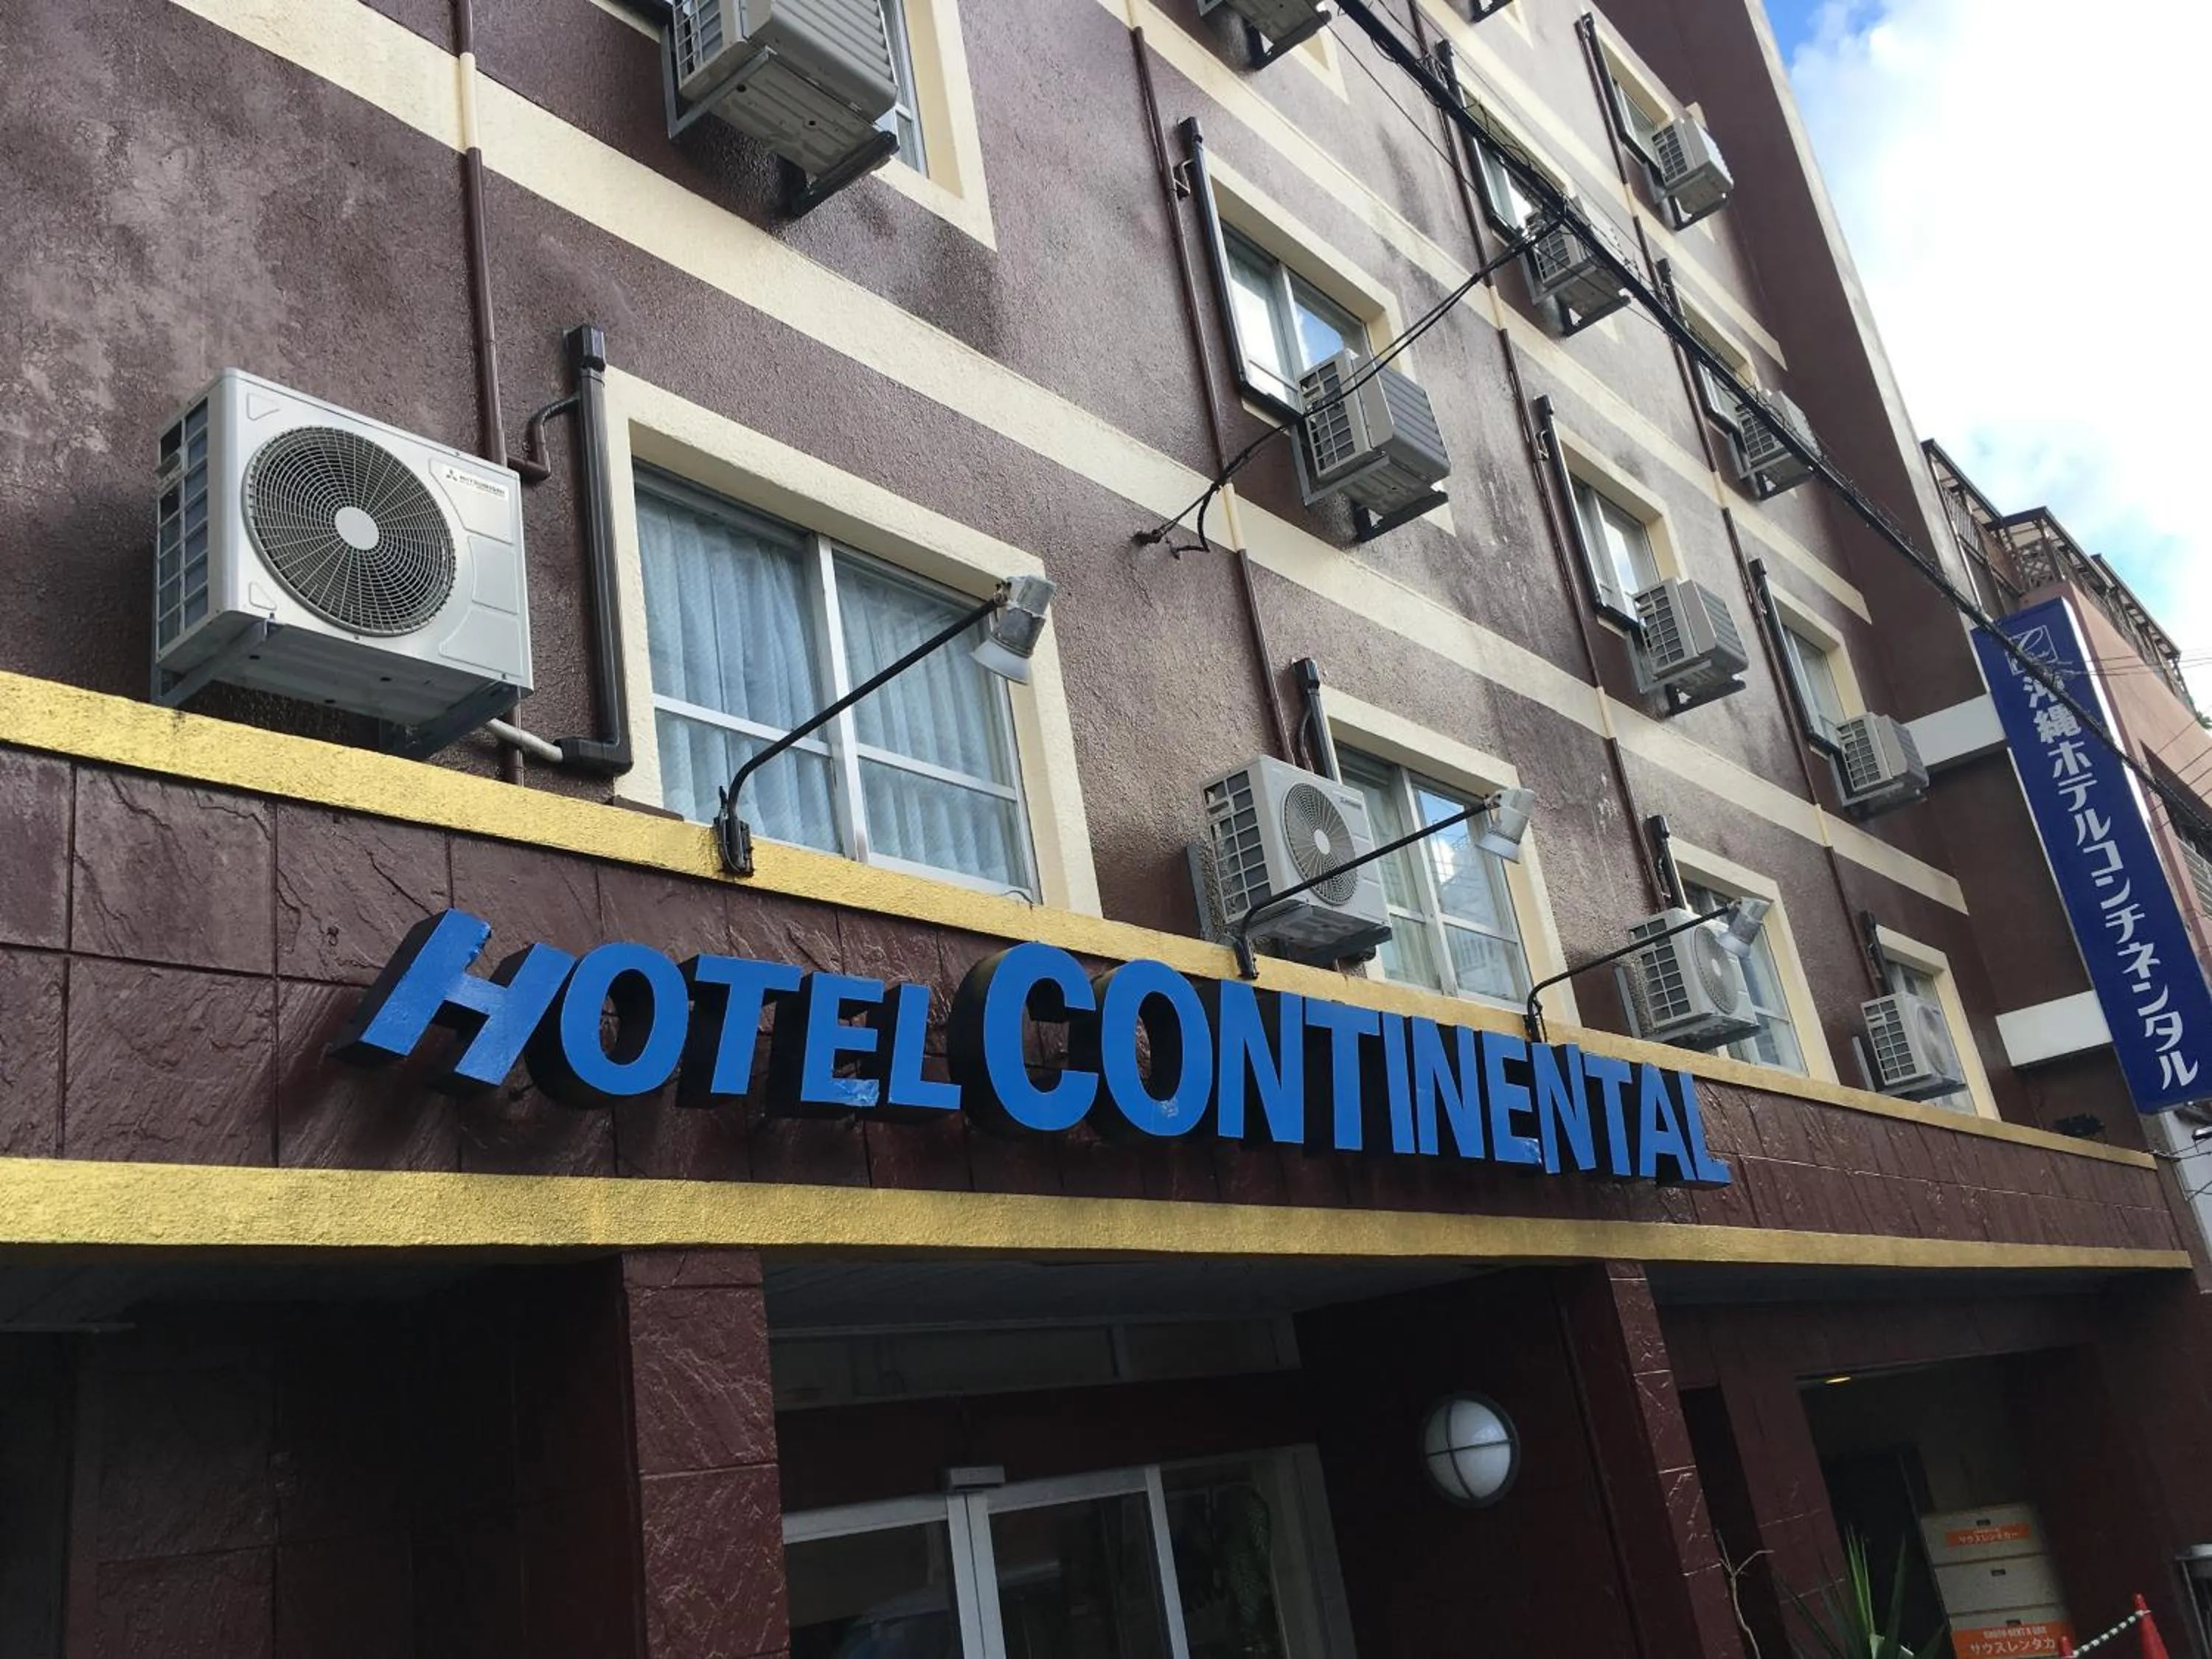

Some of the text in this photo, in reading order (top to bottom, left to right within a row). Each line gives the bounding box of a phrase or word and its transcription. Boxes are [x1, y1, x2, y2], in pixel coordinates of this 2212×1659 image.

[360, 908, 1731, 1182] HOTEL CONTINENTAL
[1969, 1637, 2056, 1655] サウスレンタカ
